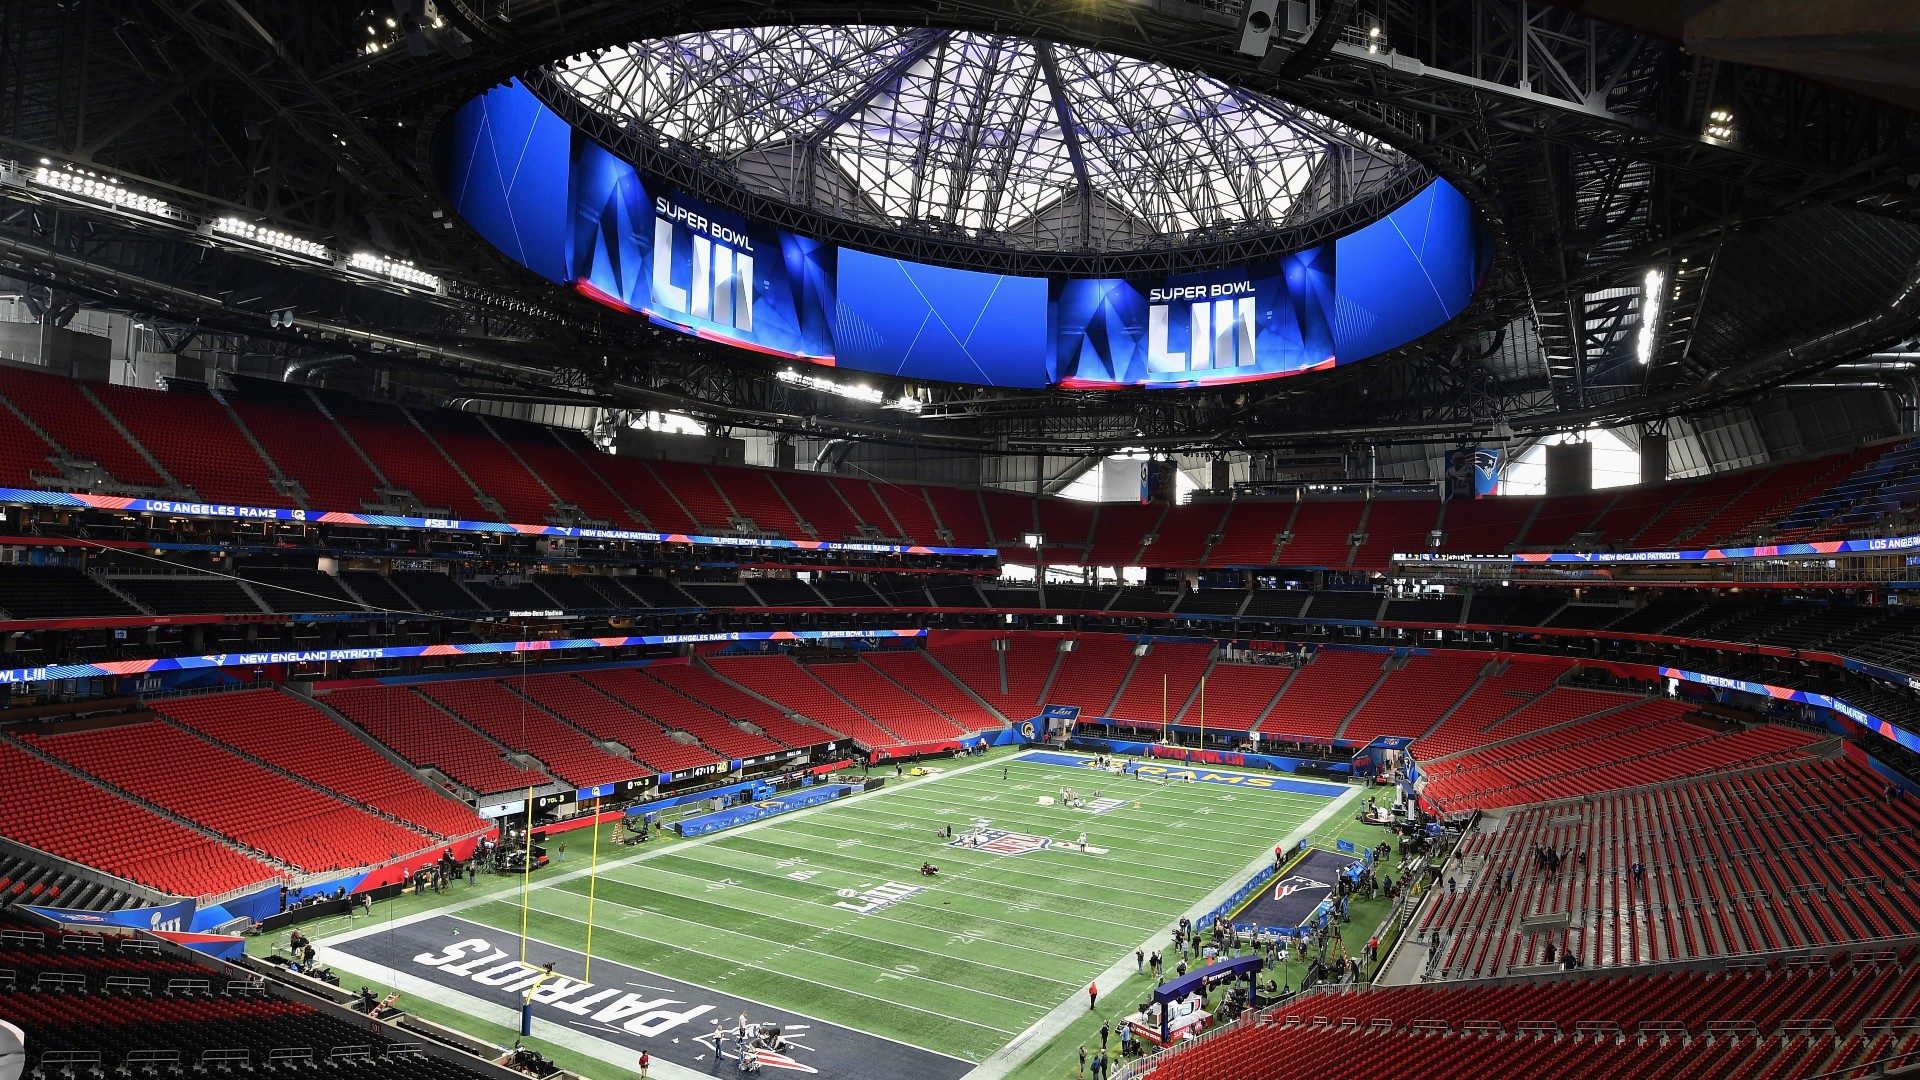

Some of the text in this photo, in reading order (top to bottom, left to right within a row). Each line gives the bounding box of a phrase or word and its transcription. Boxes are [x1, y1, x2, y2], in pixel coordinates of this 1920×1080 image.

[655, 196, 754, 251] SUPER BOWL
[652, 217, 754, 332] LIII
[1150, 280, 1256, 300] SUPER BOWL
[1147, 296, 1256, 374] LIII
[146, 500, 277, 519] LOS ANGELES RAMS
[424, 518, 459, 529] #SBLIII
[579, 529, 661, 542] NEW ENGLAND PATRIOTS
[712, 536, 772, 547] SUPER BOWL LIII
[842, 543, 872, 551] ANGELES
[1869, 539, 1887, 551] LOS
[1888, 537, 1912, 550] ANGELES
[1599, 551, 1680, 561] NEW ENGLAND PATRIOTS
[663, 633, 727, 643] LOS ANGELES RAMS
[821, 631, 845, 639] SUPER
[845, 630, 865, 638] BOWL
[239, 648, 383, 664] NEW ENGLAND PATRIOTS
[24, 667, 46, 681] LIII
[1700, 674, 1746, 691] SUPER BOWL LIII
[694, 765, 716, 777] 47:19
[1137, 766, 1276, 787] RAMS
[627, 781, 633, 790] 0
[539, 797, 547, 807] 0
[547, 796, 558, 804] TOL
[412, 938, 717, 1038] PATRIOTS
